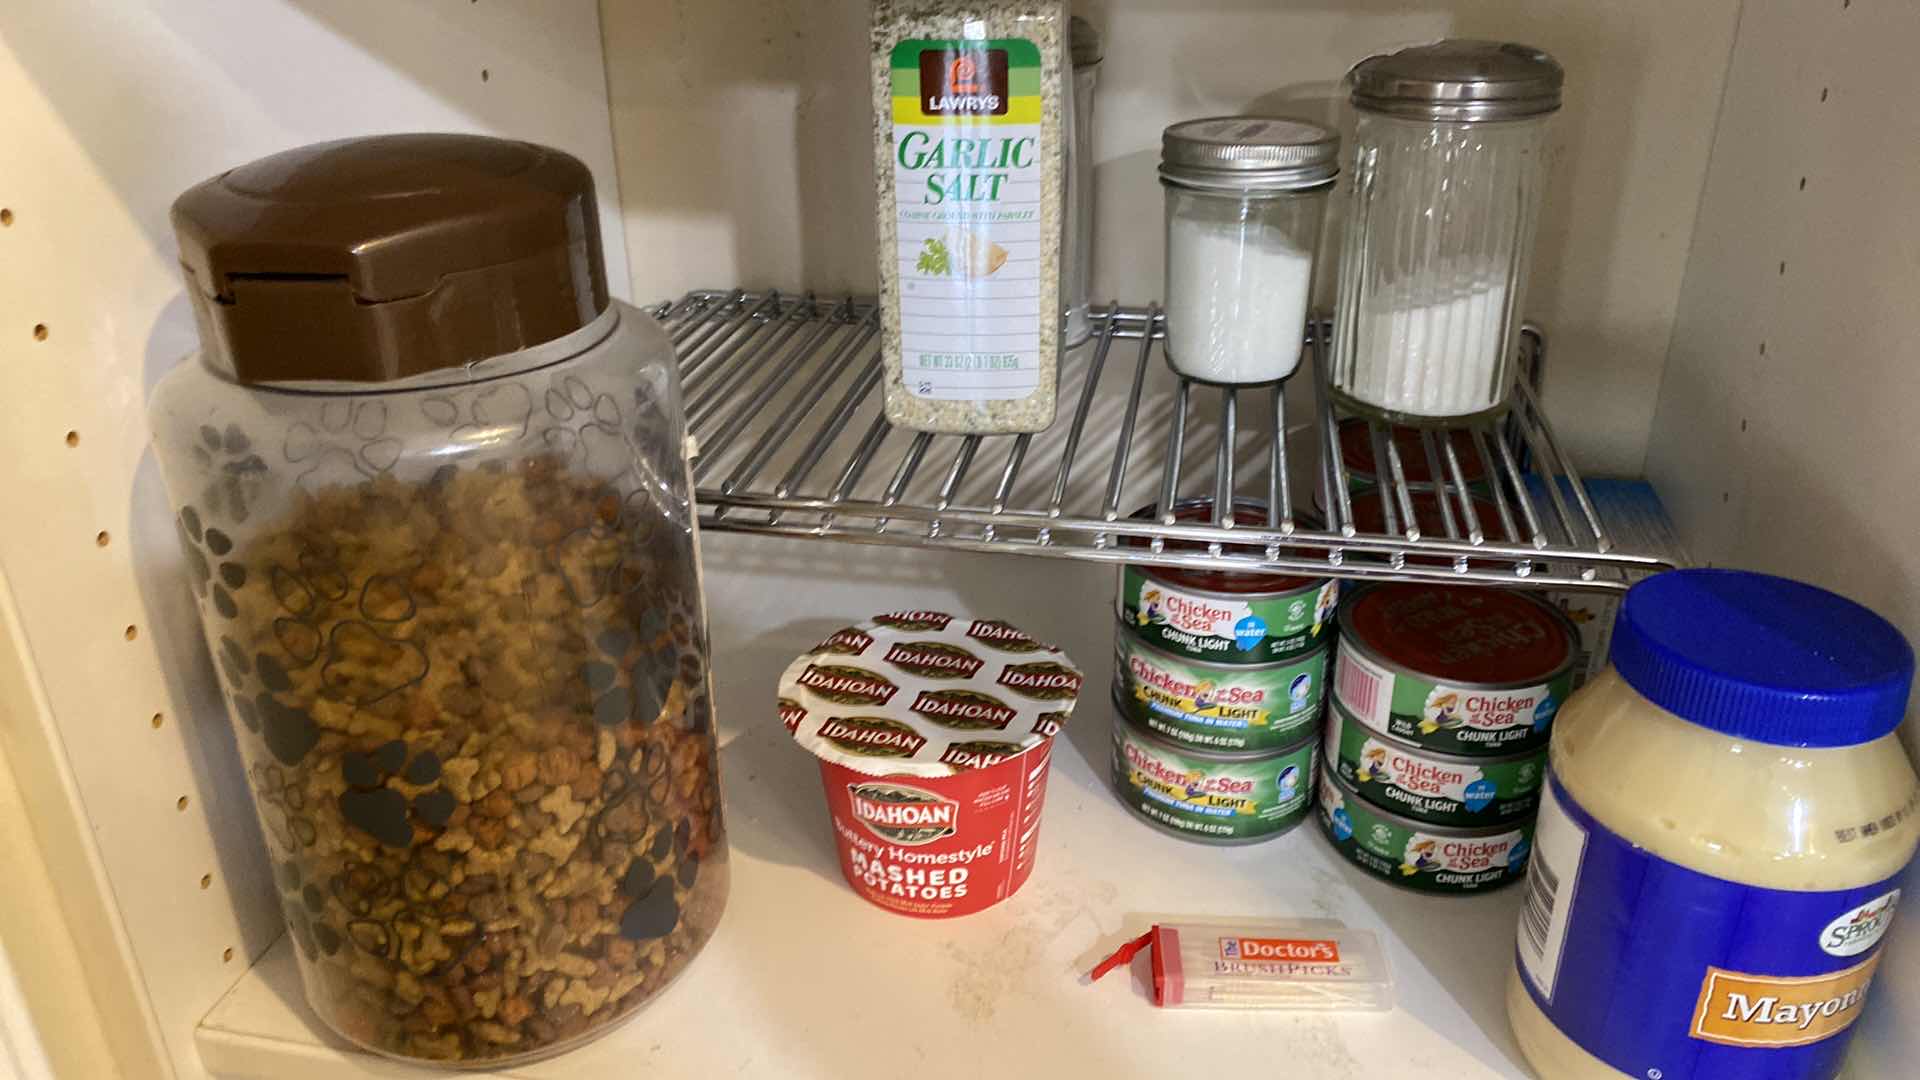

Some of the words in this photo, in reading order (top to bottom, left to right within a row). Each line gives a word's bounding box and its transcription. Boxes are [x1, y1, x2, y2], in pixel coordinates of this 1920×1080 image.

[898, 131, 1035, 170] GARLIC
[924, 174, 1009, 205] SALT
[1166, 596, 1232, 622] Chicken
[1181, 614, 1213, 632] Sea
[1235, 627, 1267, 637] water
[1161, 628, 1198, 647] CHUNK
[1198, 636, 1231, 652] LIGHT
[887, 647, 979, 672] IDAHOAN
[800, 669, 893, 699] IDAHOAN
[1130, 656, 1197, 698] Chicken
[1229, 686, 1265, 705] Sea
[914, 697, 1010, 723] IDAHOAN
[1219, 705, 1258, 719] LIGHT
[1466, 696, 1534, 717] Chicken
[1481, 712, 1515, 727] Sea
[823, 721, 920, 750] IDAHOAN
[1456, 729, 1498, 742] CHUNK
[1499, 728, 1529, 741] LIGHT
[1125, 743, 1186, 786] Chicken
[1218, 777, 1254, 793] Sea
[1391, 757, 1463, 785] Chicken
[1407, 774, 1440, 793] Sea
[1465, 791, 1496, 800] water
[855, 797, 951, 825] IDAHOAN
[1208, 795, 1248, 809] LIGHT
[1385, 786, 1424, 808] CHUNK
[1424, 799, 1459, 813] LIGHT
[887, 841, 994, 865] Homestyle
[1443, 842, 1509, 858] Chicken
[850, 847, 969, 886] MASHED
[1459, 857, 1490, 870] Sea
[852, 863, 968, 899] POTATOES
[1435, 873, 1474, 884] CHUNK
[1475, 870, 1503, 883] LIGHT
[1243, 941, 1334, 959] Doctor's
